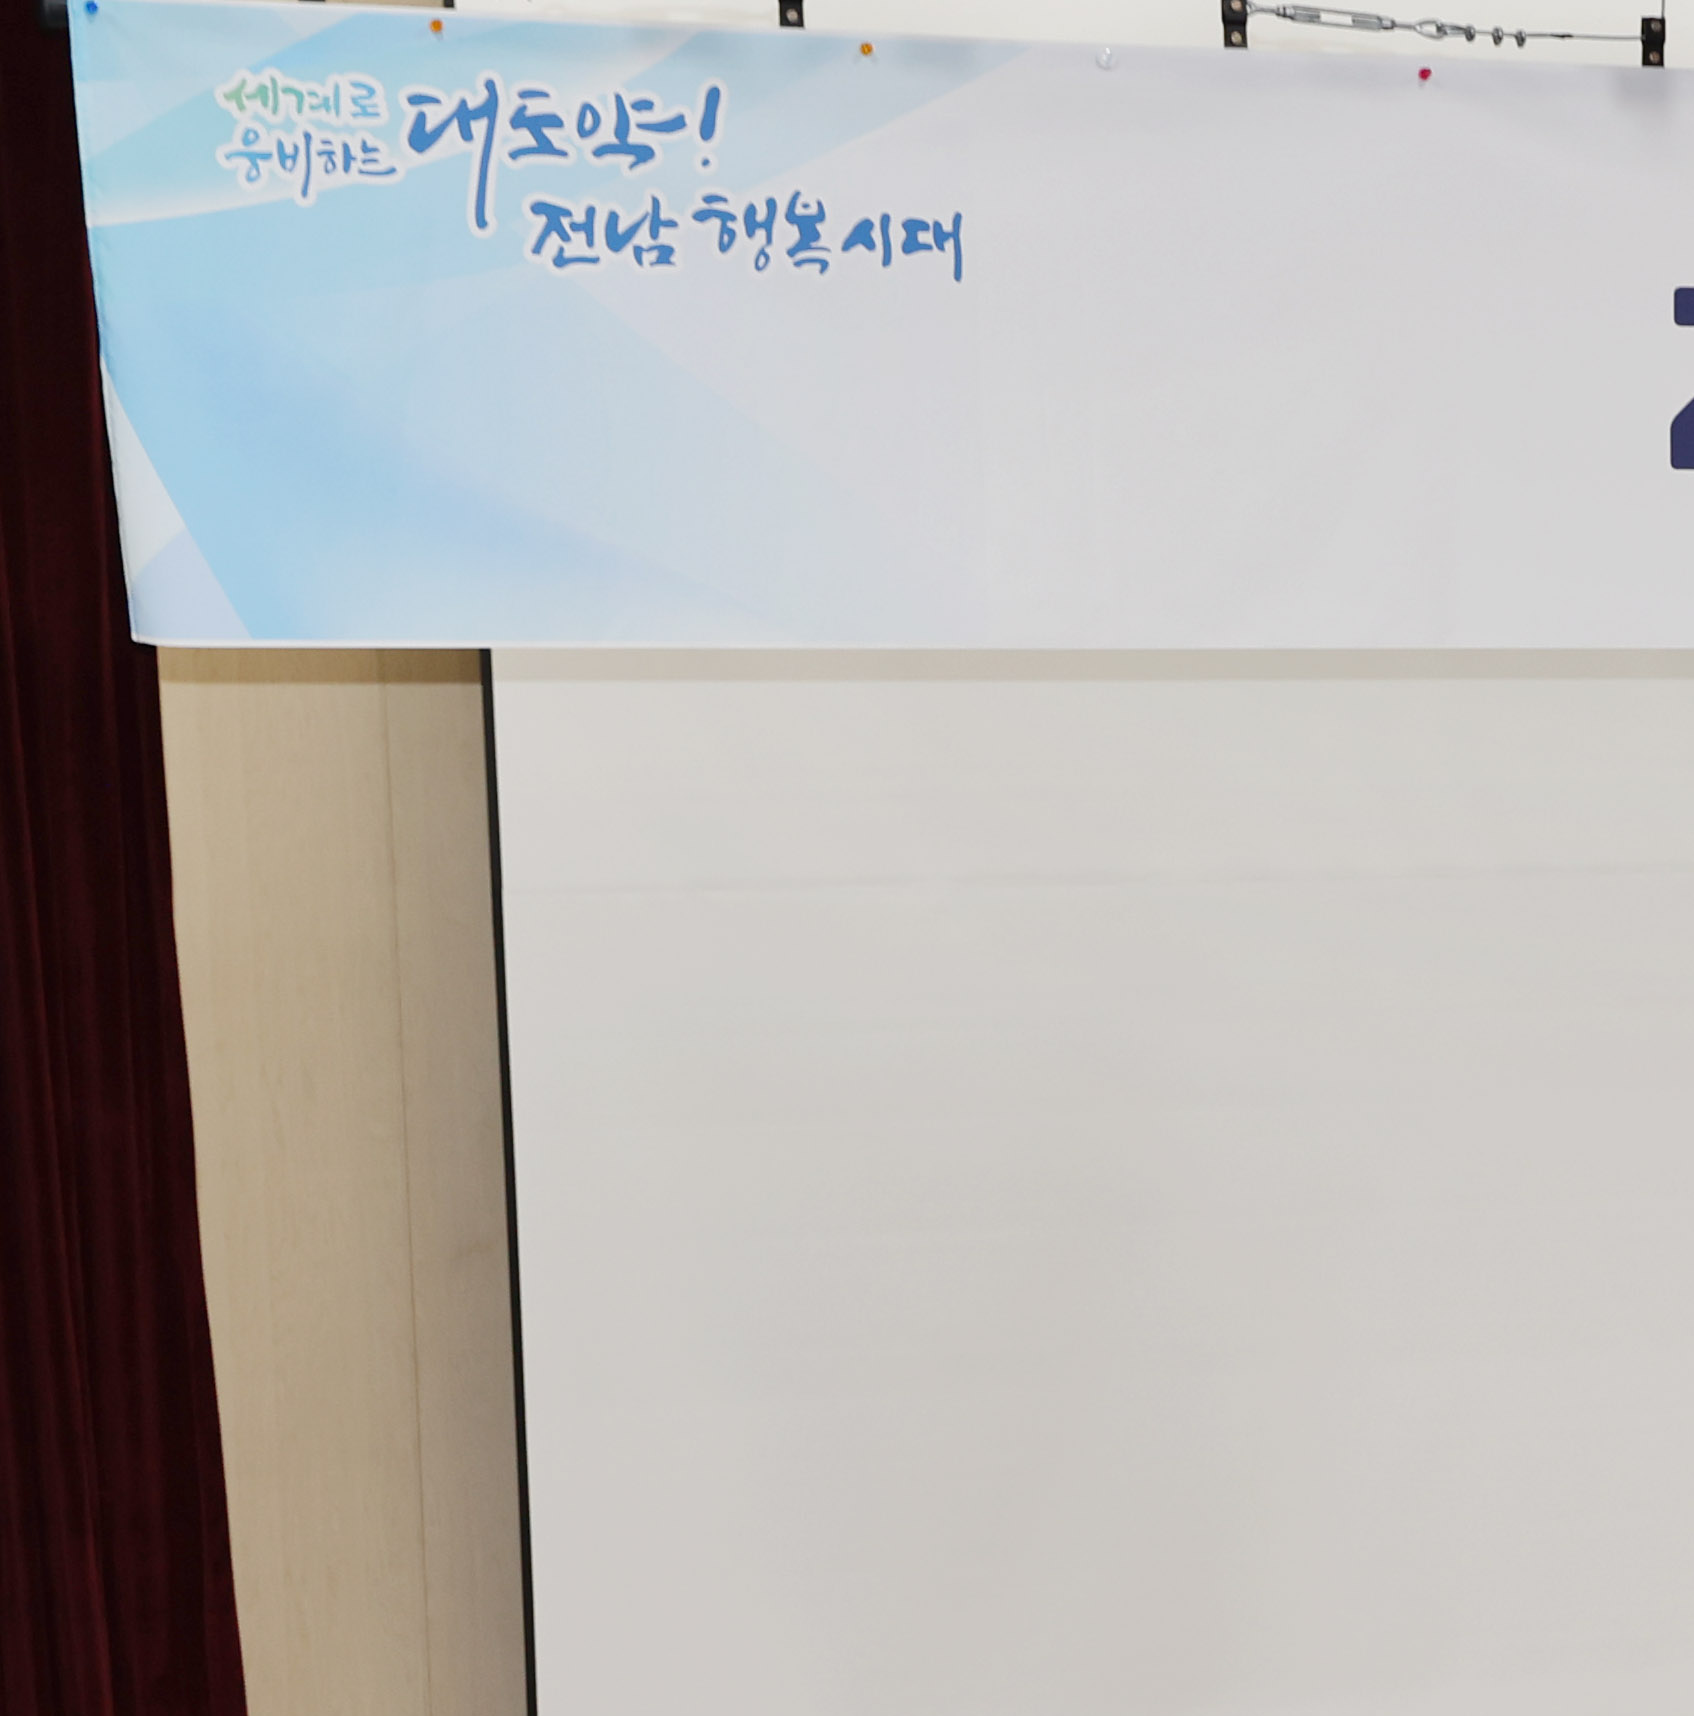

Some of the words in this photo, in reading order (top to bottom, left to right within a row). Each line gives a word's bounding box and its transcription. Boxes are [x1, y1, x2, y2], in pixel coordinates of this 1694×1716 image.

[223, 74, 385, 121] 세계로
[224, 129, 398, 198] 웅비하는
[406, 79, 722, 229] 대도약!
[529, 196, 679, 269] 전남
